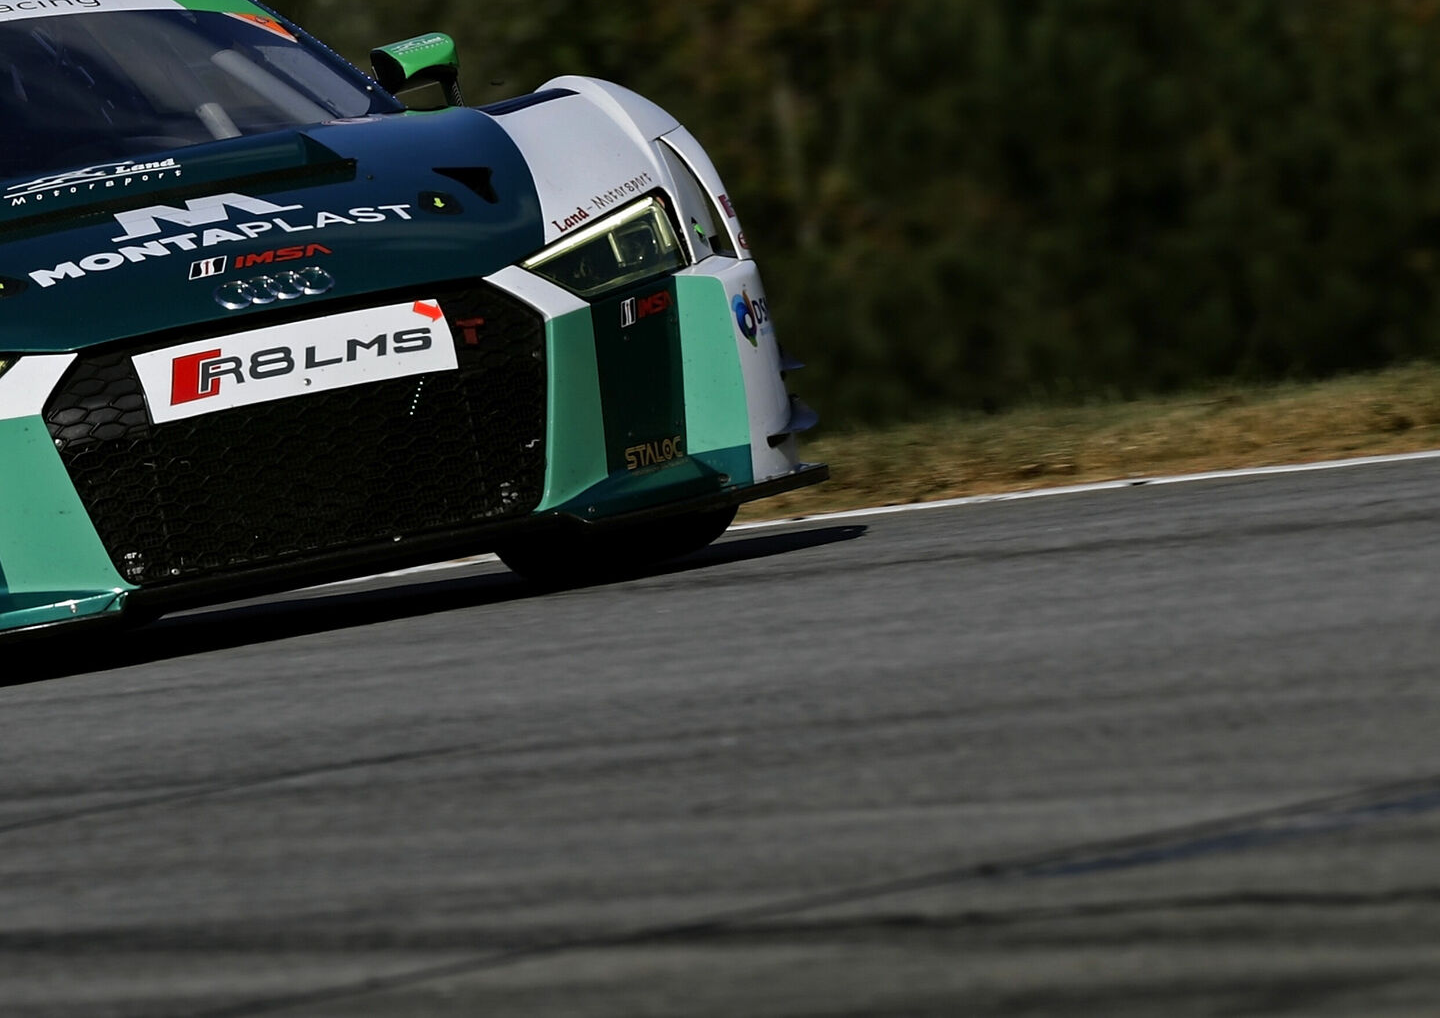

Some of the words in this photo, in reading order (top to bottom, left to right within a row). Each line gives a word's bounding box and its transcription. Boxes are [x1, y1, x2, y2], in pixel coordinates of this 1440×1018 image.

[115, 157, 176, 174] Land
[28, 204, 412, 288] MONTAPLAST
[234, 243, 333, 269] IMSA
[186, 346, 296, 397] R8
[624, 435, 685, 471] STALOC
